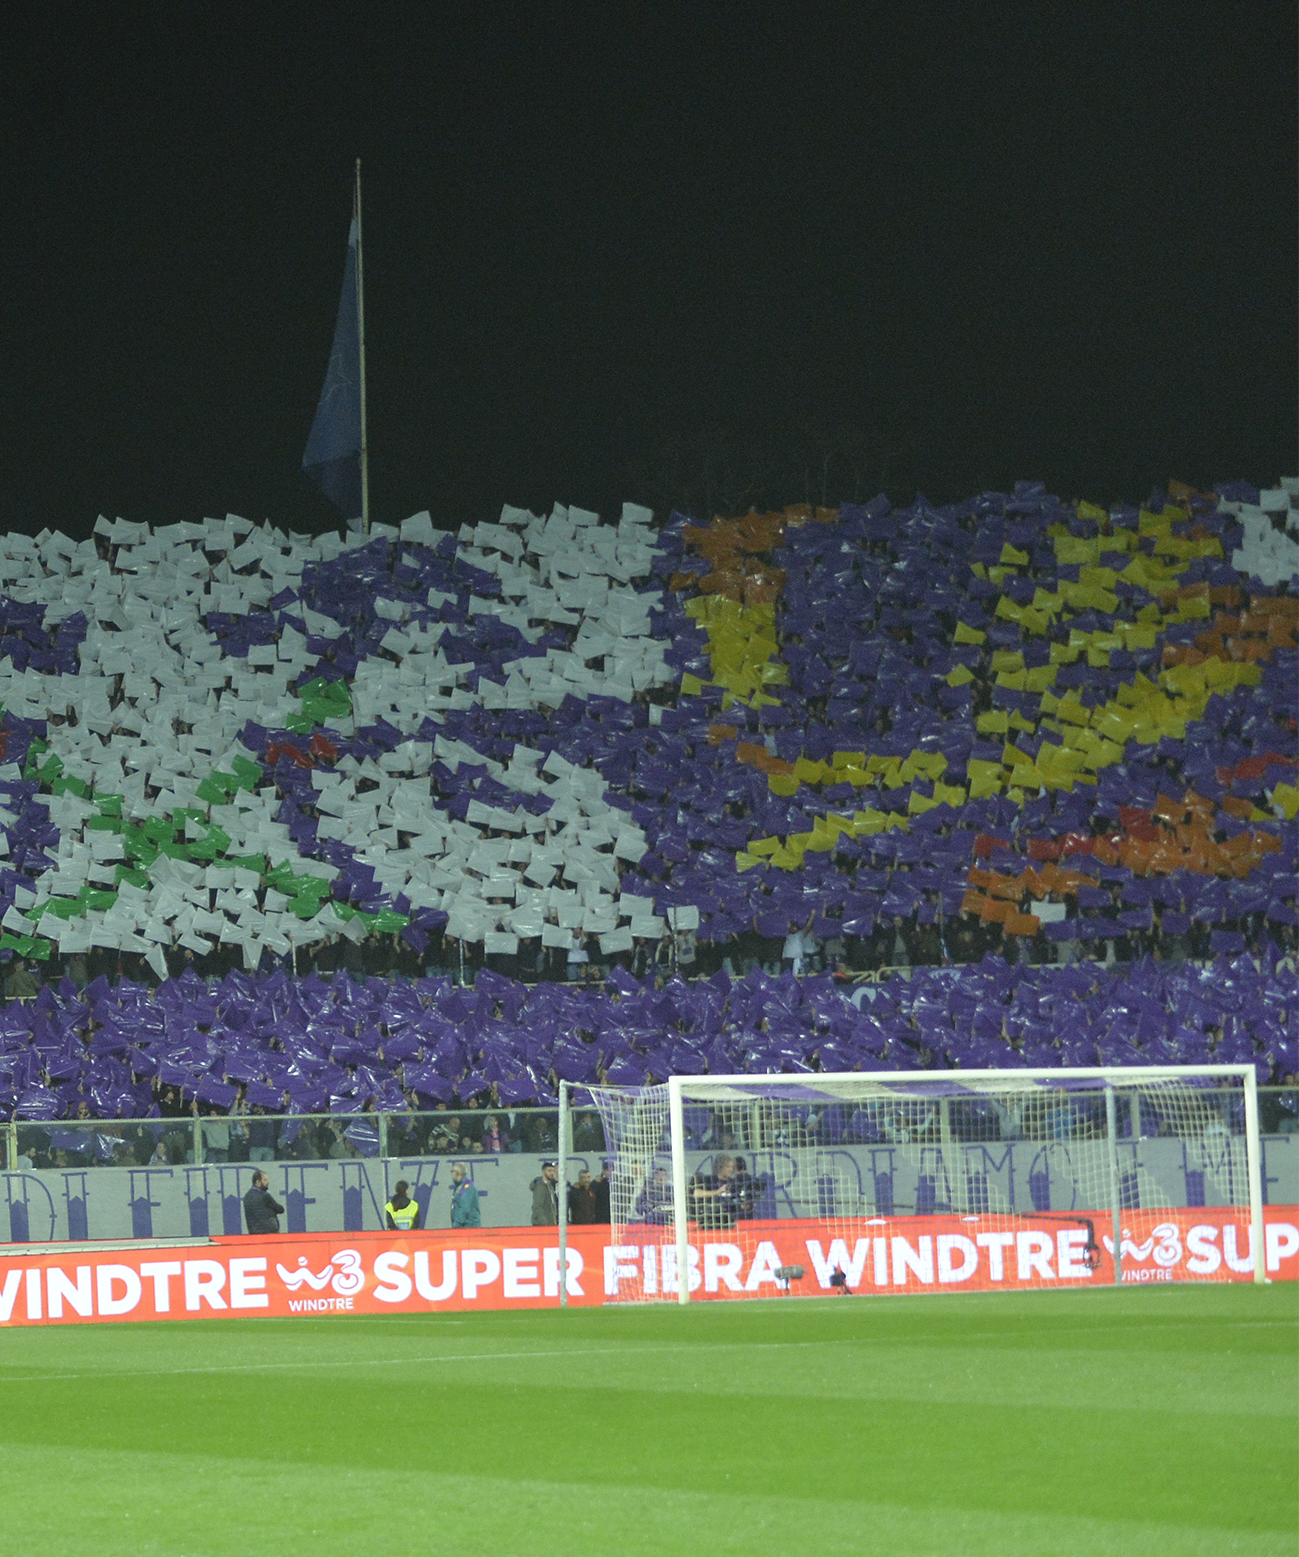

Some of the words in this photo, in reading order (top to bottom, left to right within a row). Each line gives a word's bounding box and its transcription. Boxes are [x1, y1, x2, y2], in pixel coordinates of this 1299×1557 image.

[373, 1246, 585, 1303] SUPER
[603, 1241, 790, 1295] FIBRA
[805, 1228, 1094, 1289] WINDTRE
[288, 1297, 354, 1311] WINDTRE
